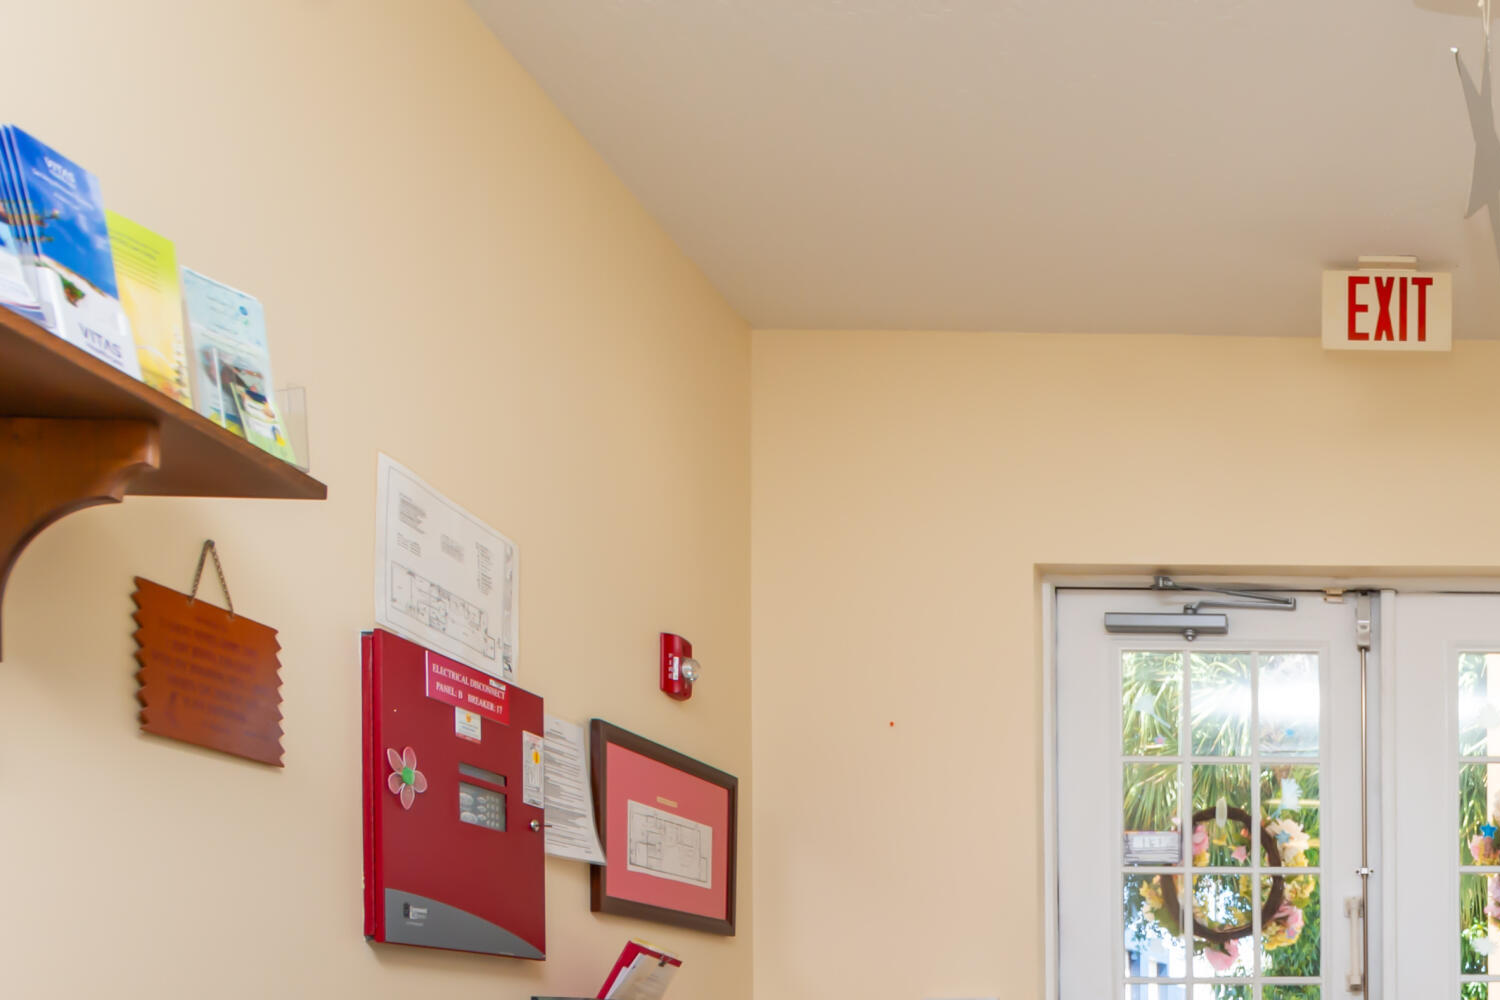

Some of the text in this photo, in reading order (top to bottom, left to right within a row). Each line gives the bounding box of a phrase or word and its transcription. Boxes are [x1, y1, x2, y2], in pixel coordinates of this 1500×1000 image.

[1347, 275, 1433, 342] EXIT
[77, 321, 122, 359] VITAS
[432, 663, 505, 700] ELECTRICAL DISCONNECT
